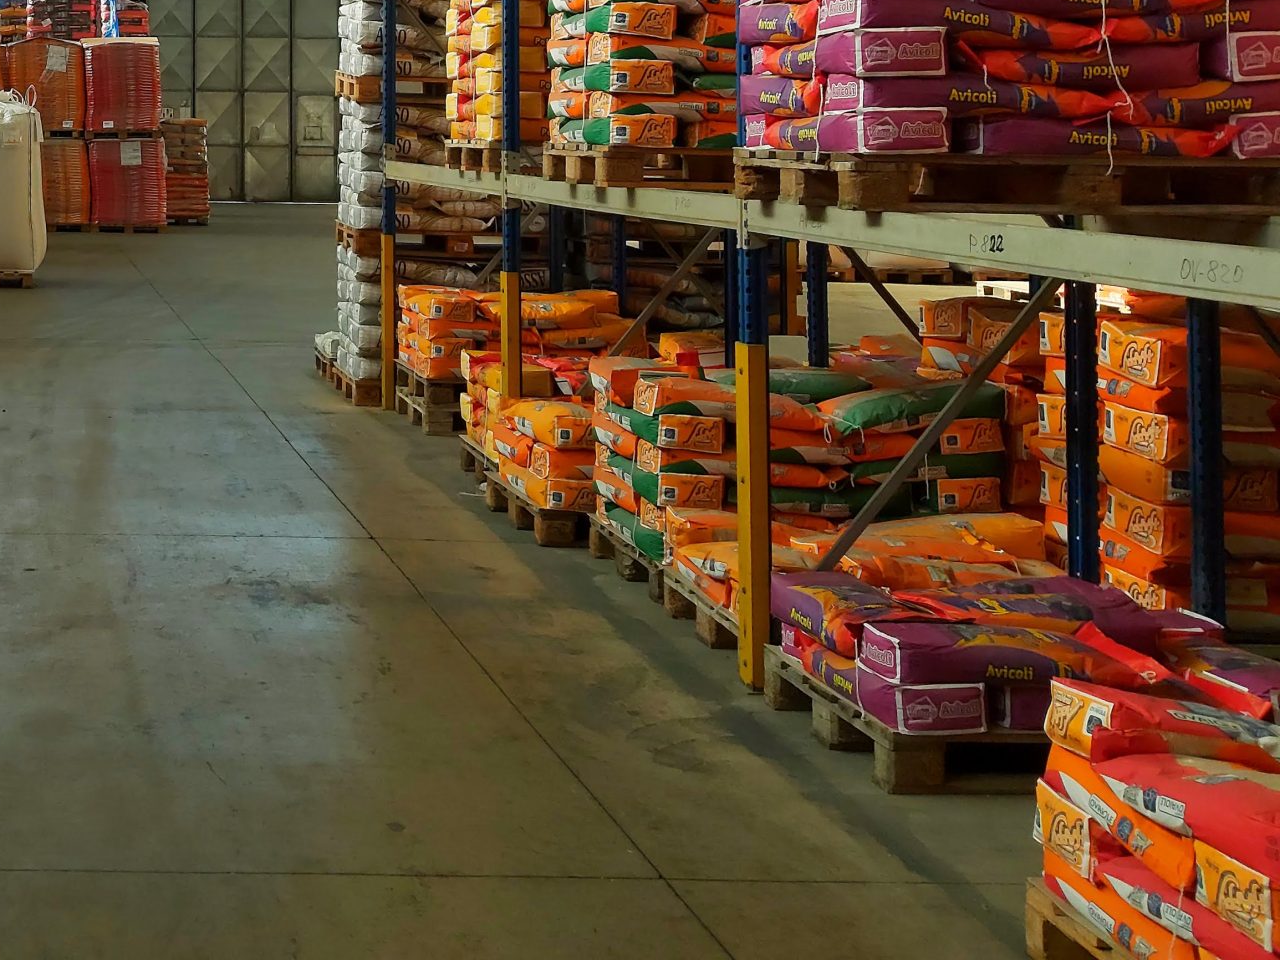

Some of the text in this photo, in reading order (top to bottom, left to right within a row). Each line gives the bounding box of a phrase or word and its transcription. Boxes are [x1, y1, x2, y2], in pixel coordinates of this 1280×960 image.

[943, 7, 990, 27] Avicoli
[1205, 10, 1251, 27] Avicoli
[900, 45, 939, 58] Avicoli
[1083, 64, 1130, 79] Avicoli
[949, 88, 997, 104] Avicoli
[1205, 98, 1253, 114] Avicoli
[902, 124, 942, 137] Avicoli
[1069, 131, 1117, 146] Avicoli
[1180, 258, 1244, 284] OV-820
[790, 607, 812, 630] Avicoli
[985, 664, 1034, 680] Avicoli
